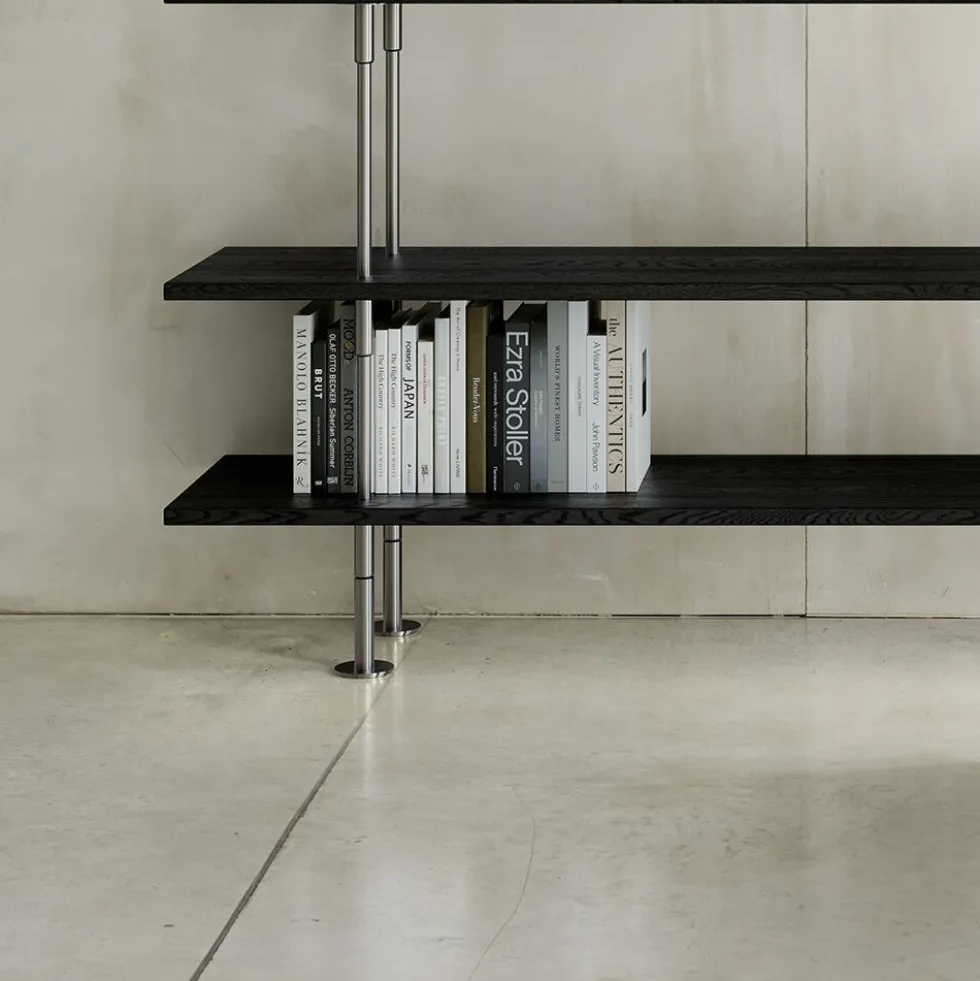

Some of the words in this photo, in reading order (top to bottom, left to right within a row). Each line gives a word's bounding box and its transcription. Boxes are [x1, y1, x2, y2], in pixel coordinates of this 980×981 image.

[608, 318, 620, 337] the
[297, 329, 307, 391] MANOLO
[506, 332, 528, 382] Ezra
[593, 350, 601, 371] Visual
[314, 369, 322, 399] BRUT
[403, 377, 414, 419] JAPAN
[592, 373, 601, 406] Inventory
[344, 388, 353, 430] ANTON
[506, 388, 528, 465] Stoller
[608, 344, 623, 474] AUTHENTICS
[297, 399, 310, 466] BLAHNÍK
[344, 436, 353, 486] CORBIJN
